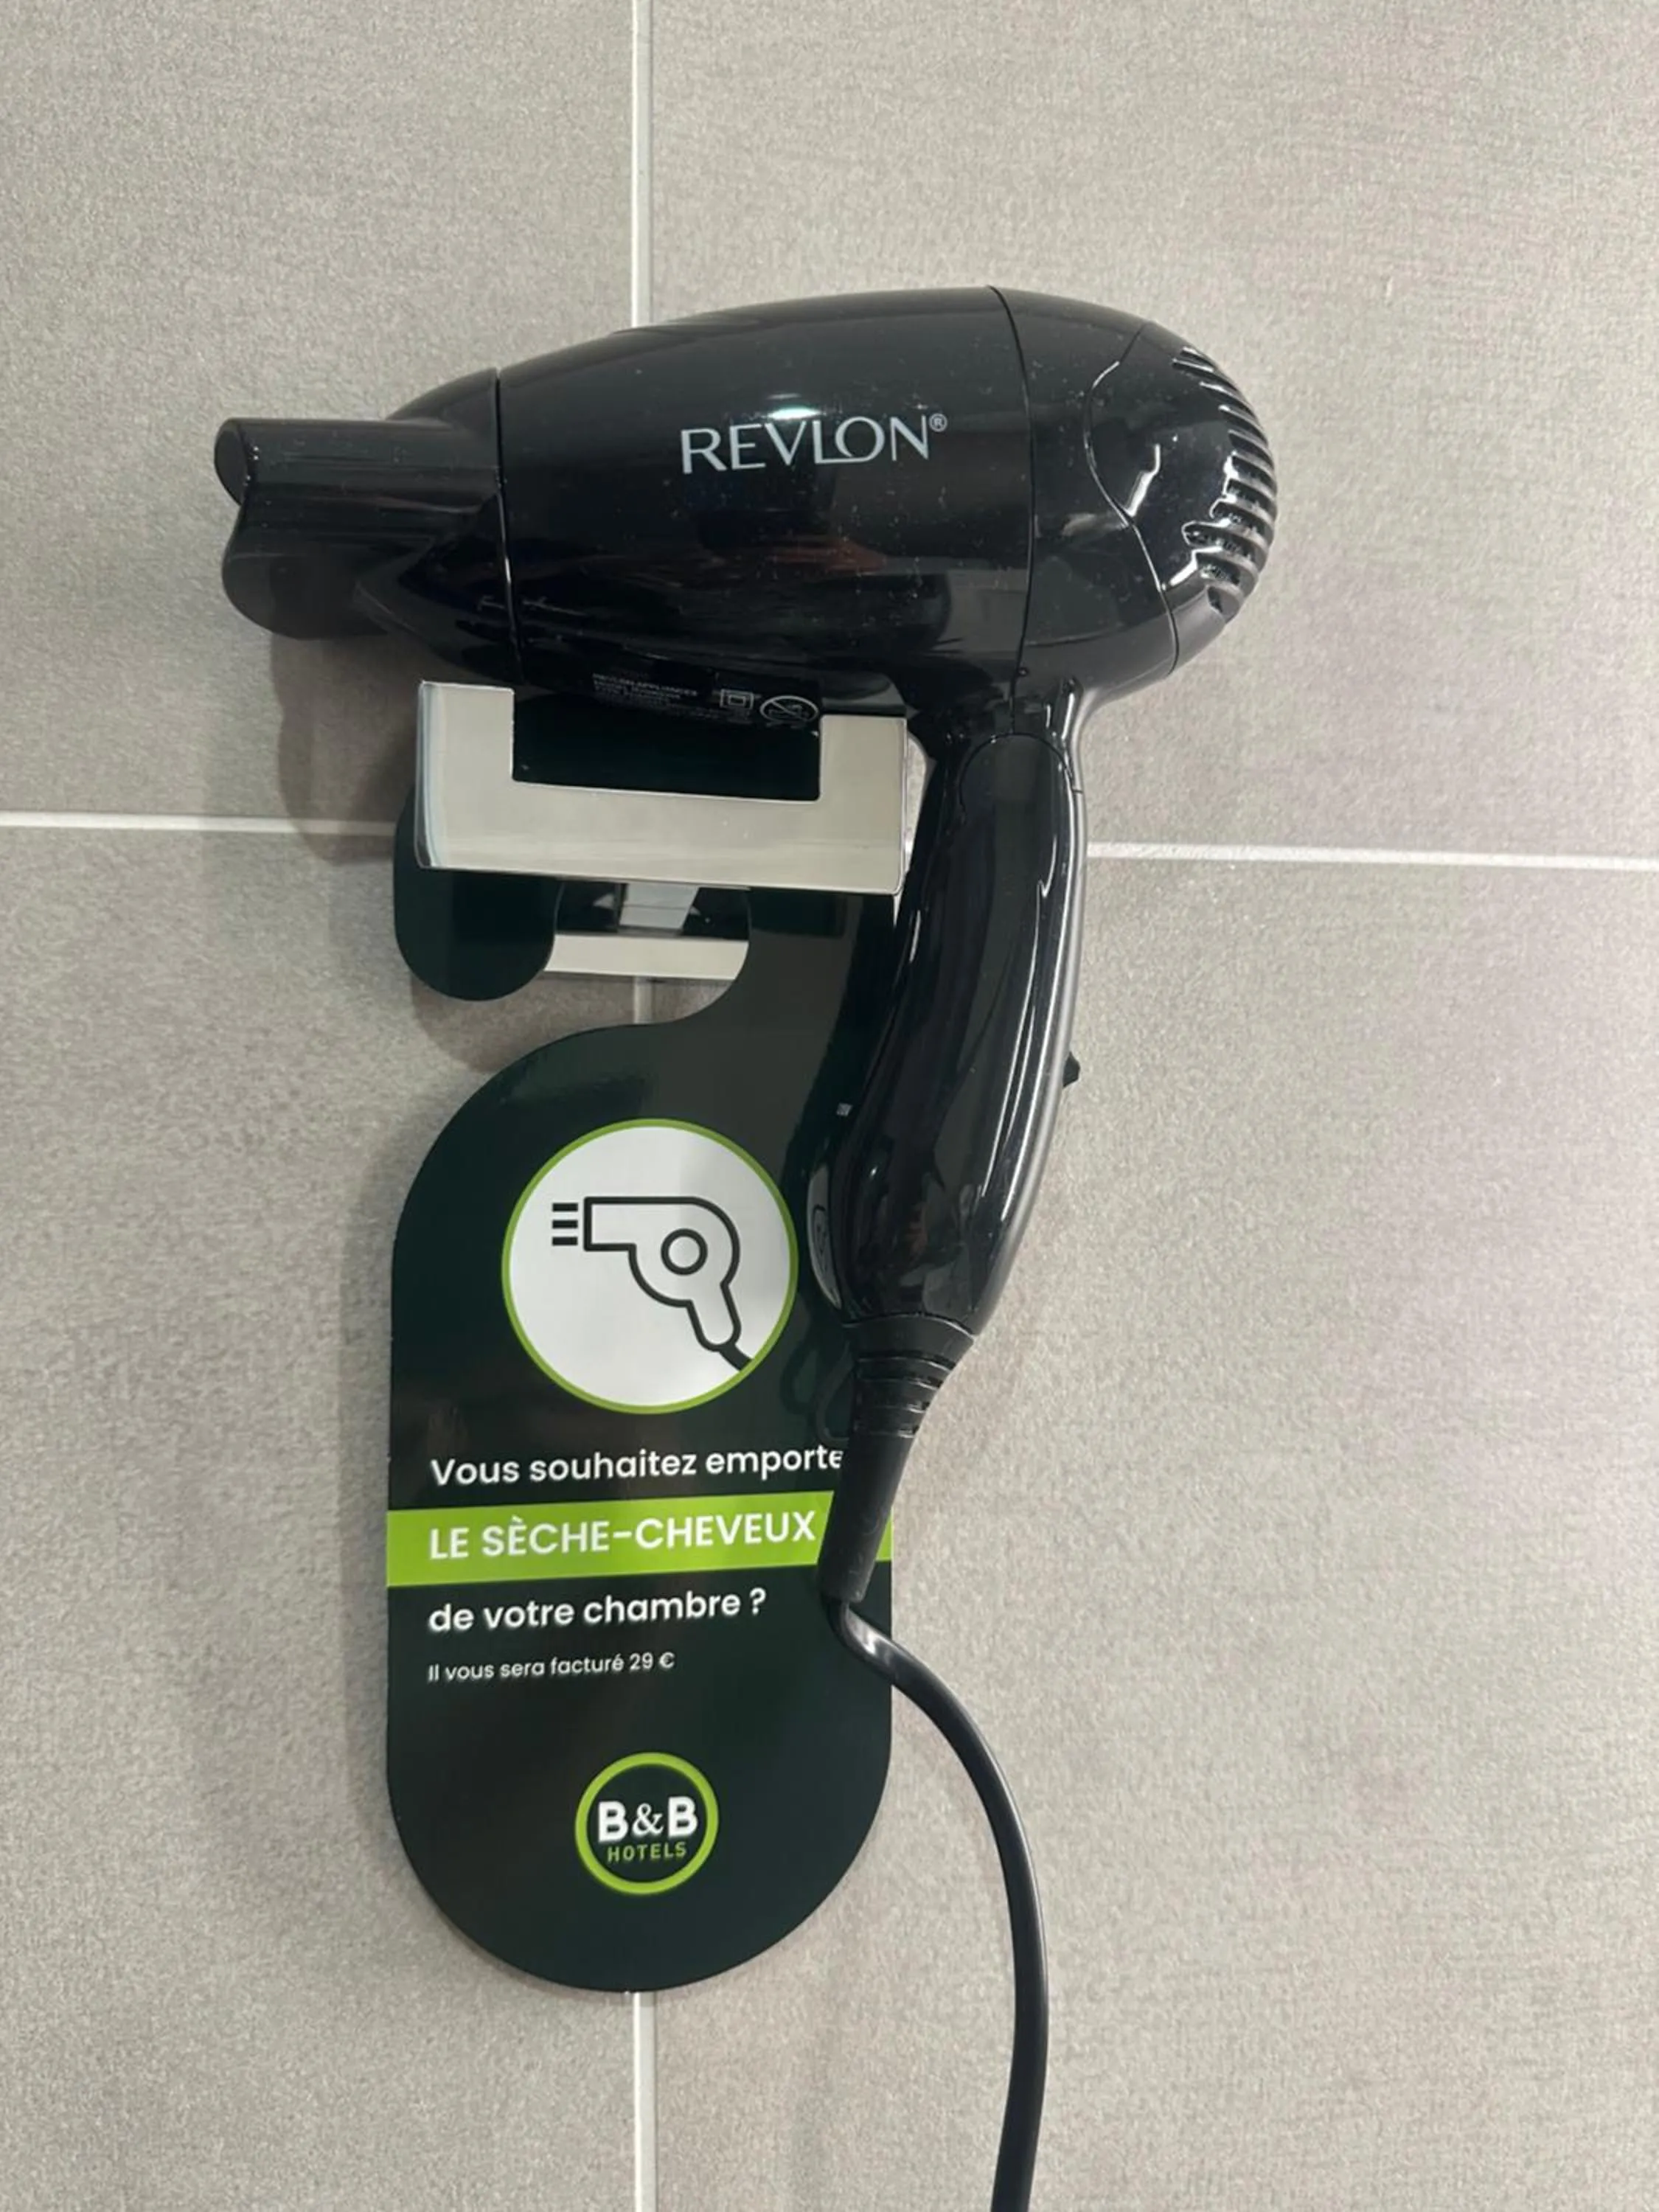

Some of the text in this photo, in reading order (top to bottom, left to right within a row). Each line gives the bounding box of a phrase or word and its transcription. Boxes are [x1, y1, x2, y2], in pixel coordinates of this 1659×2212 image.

[430, 1458, 521, 1486] Vous
[529, 1447, 698, 1483] souhaitez
[429, 1510, 816, 1560] LE SÈCHE-CHEVEUX
[428, 1586, 768, 1633] de votre chambre ?
[427, 1652, 675, 1683] Il vous sera facturé 29 €
[597, 1795, 699, 1843] B&B
[606, 1841, 688, 1864] HOTELS
